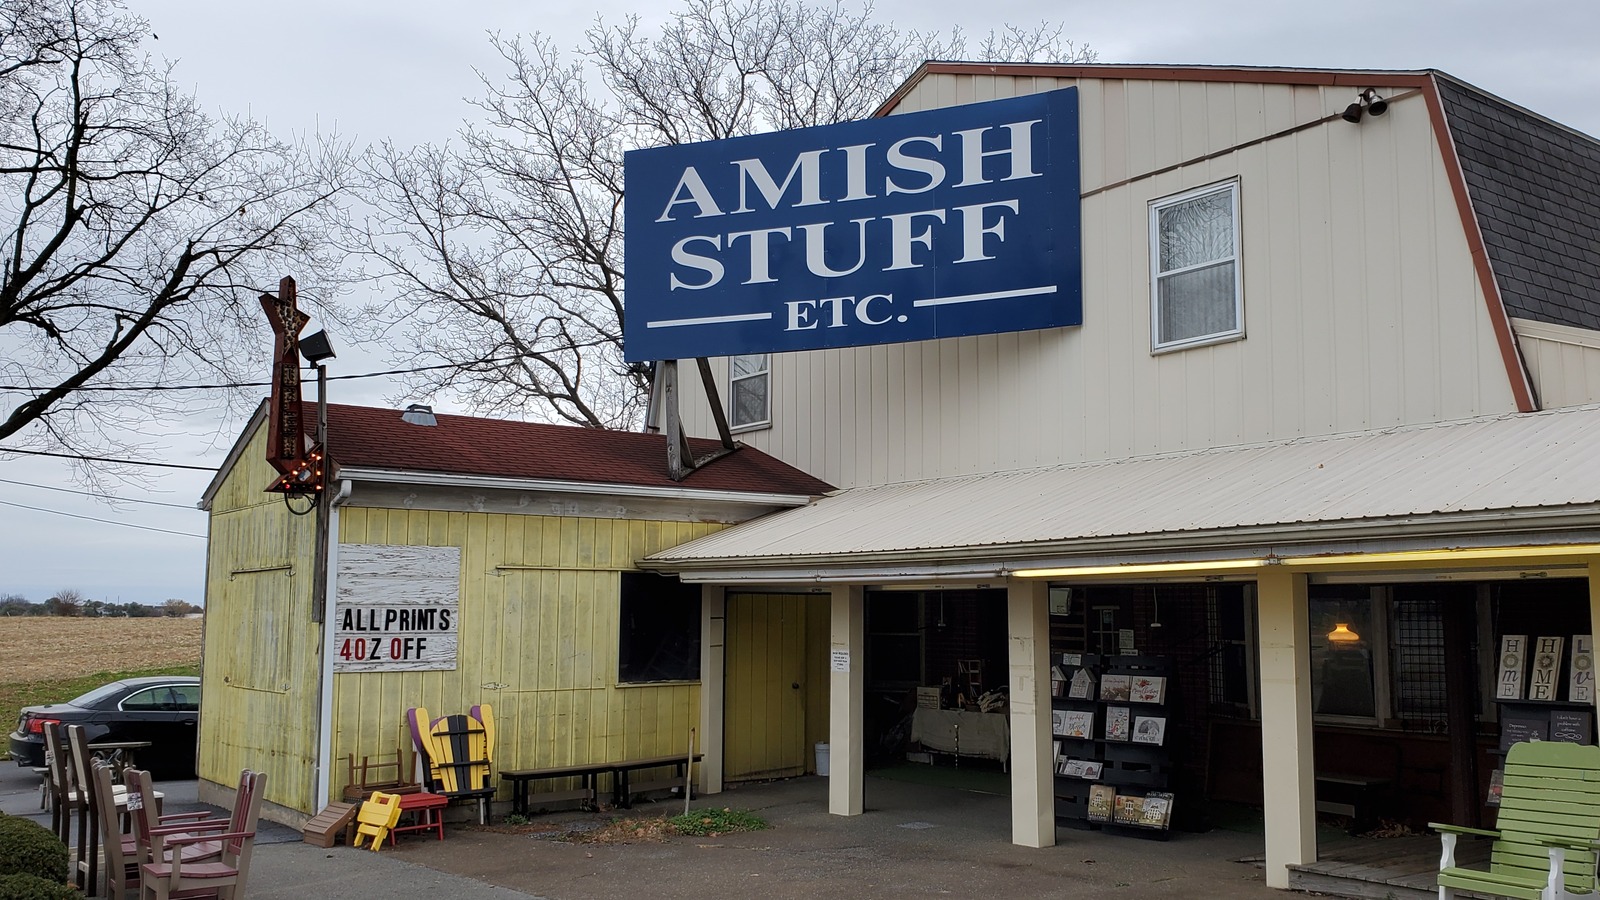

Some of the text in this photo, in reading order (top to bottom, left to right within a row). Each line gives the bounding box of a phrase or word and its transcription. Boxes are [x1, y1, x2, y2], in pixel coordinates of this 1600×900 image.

[654, 118, 1043, 223] AMISH
[670, 199, 1019, 292] STUFF
[783, 293, 908, 331] ETC.
[342, 608, 451, 631] ALL PRINTS
[390, 637, 427, 660] OFF
